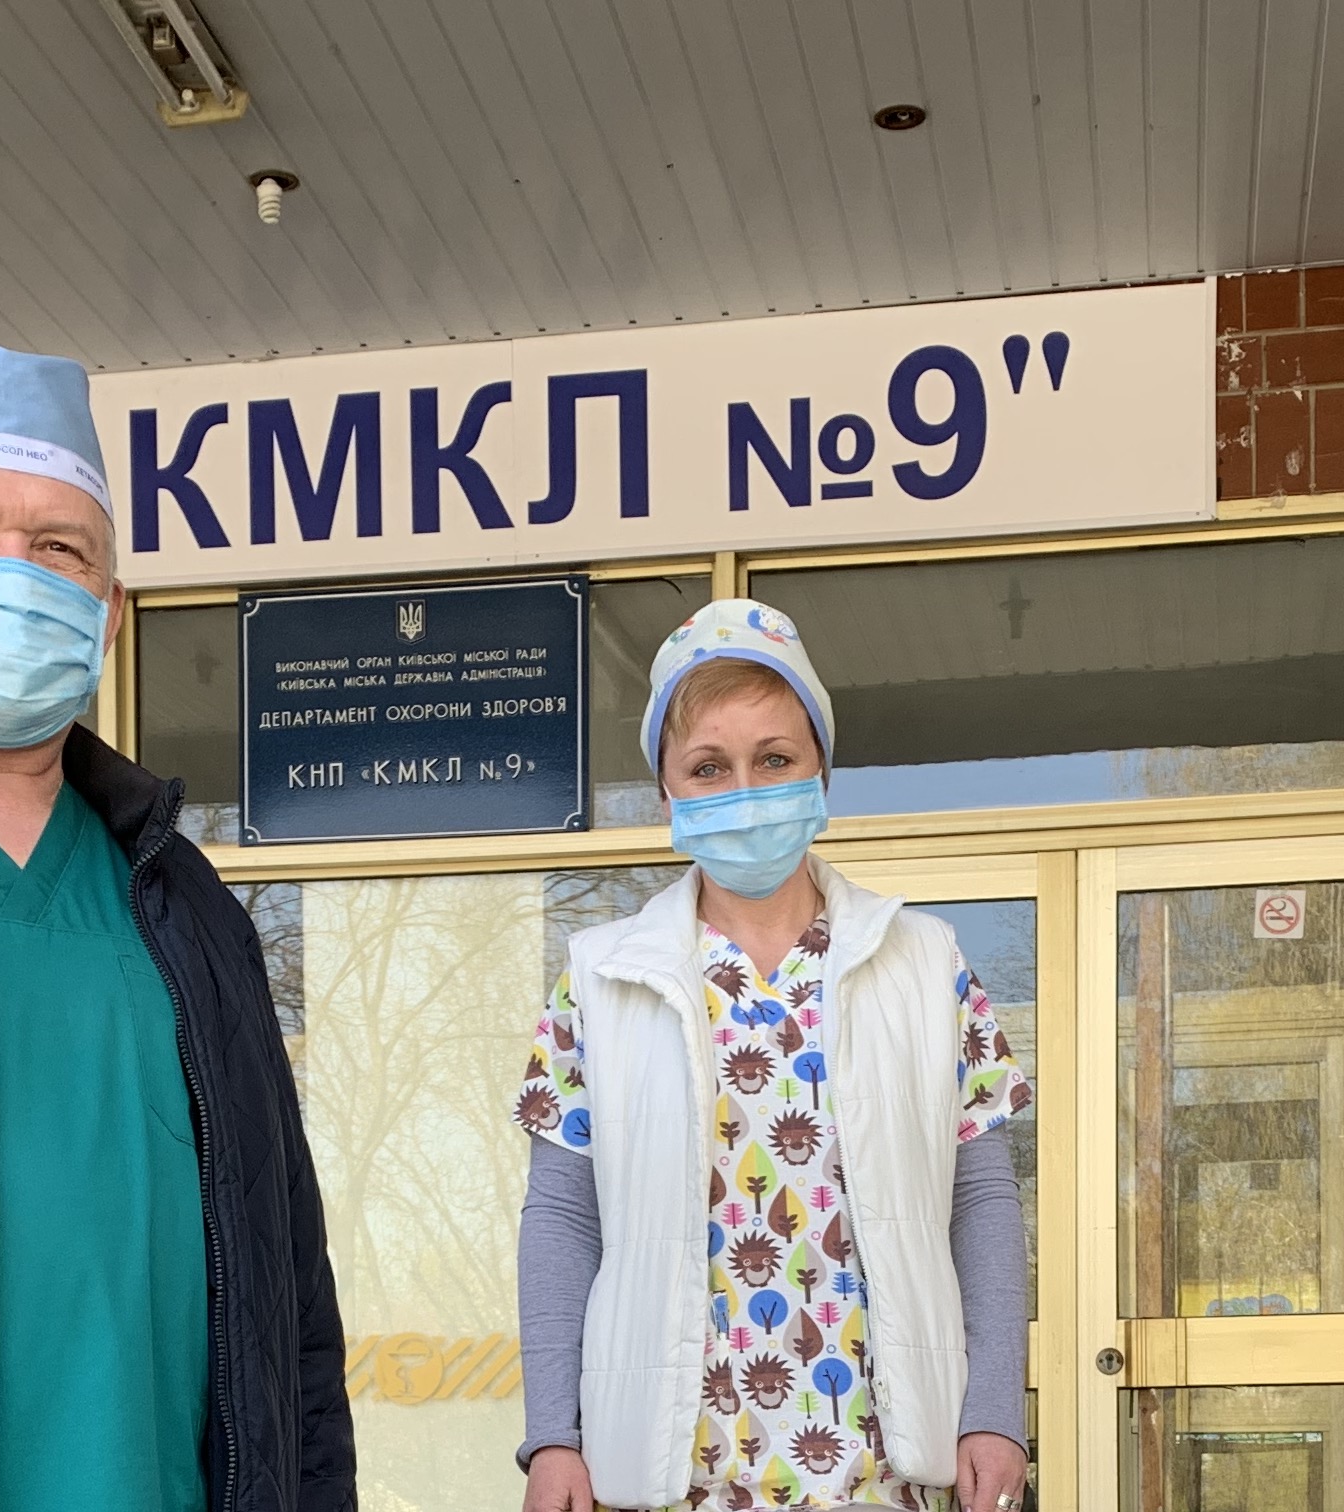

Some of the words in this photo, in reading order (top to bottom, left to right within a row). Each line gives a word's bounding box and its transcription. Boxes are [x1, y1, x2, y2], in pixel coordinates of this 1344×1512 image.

[129, 367, 650, 553] КМКЛ
[275, 656, 350, 673] ВИКОНАВЧИЙ
[356, 655, 392, 669] ОРГАН
[398, 651, 457, 667] КИЇВСЬКОЇ
[463, 647, 510, 664] МІСЬКОЇ
[515, 647, 548, 661] РАДИ
[343, 674, 387, 688] МІСЬКА
[394, 671, 454, 686] ДЕРЖАВНА
[258, 705, 378, 729] ДЕПАРТАМЕНТ
[385, 701, 473, 723] ОХОРОНИ
[287, 762, 345, 790] КНП
